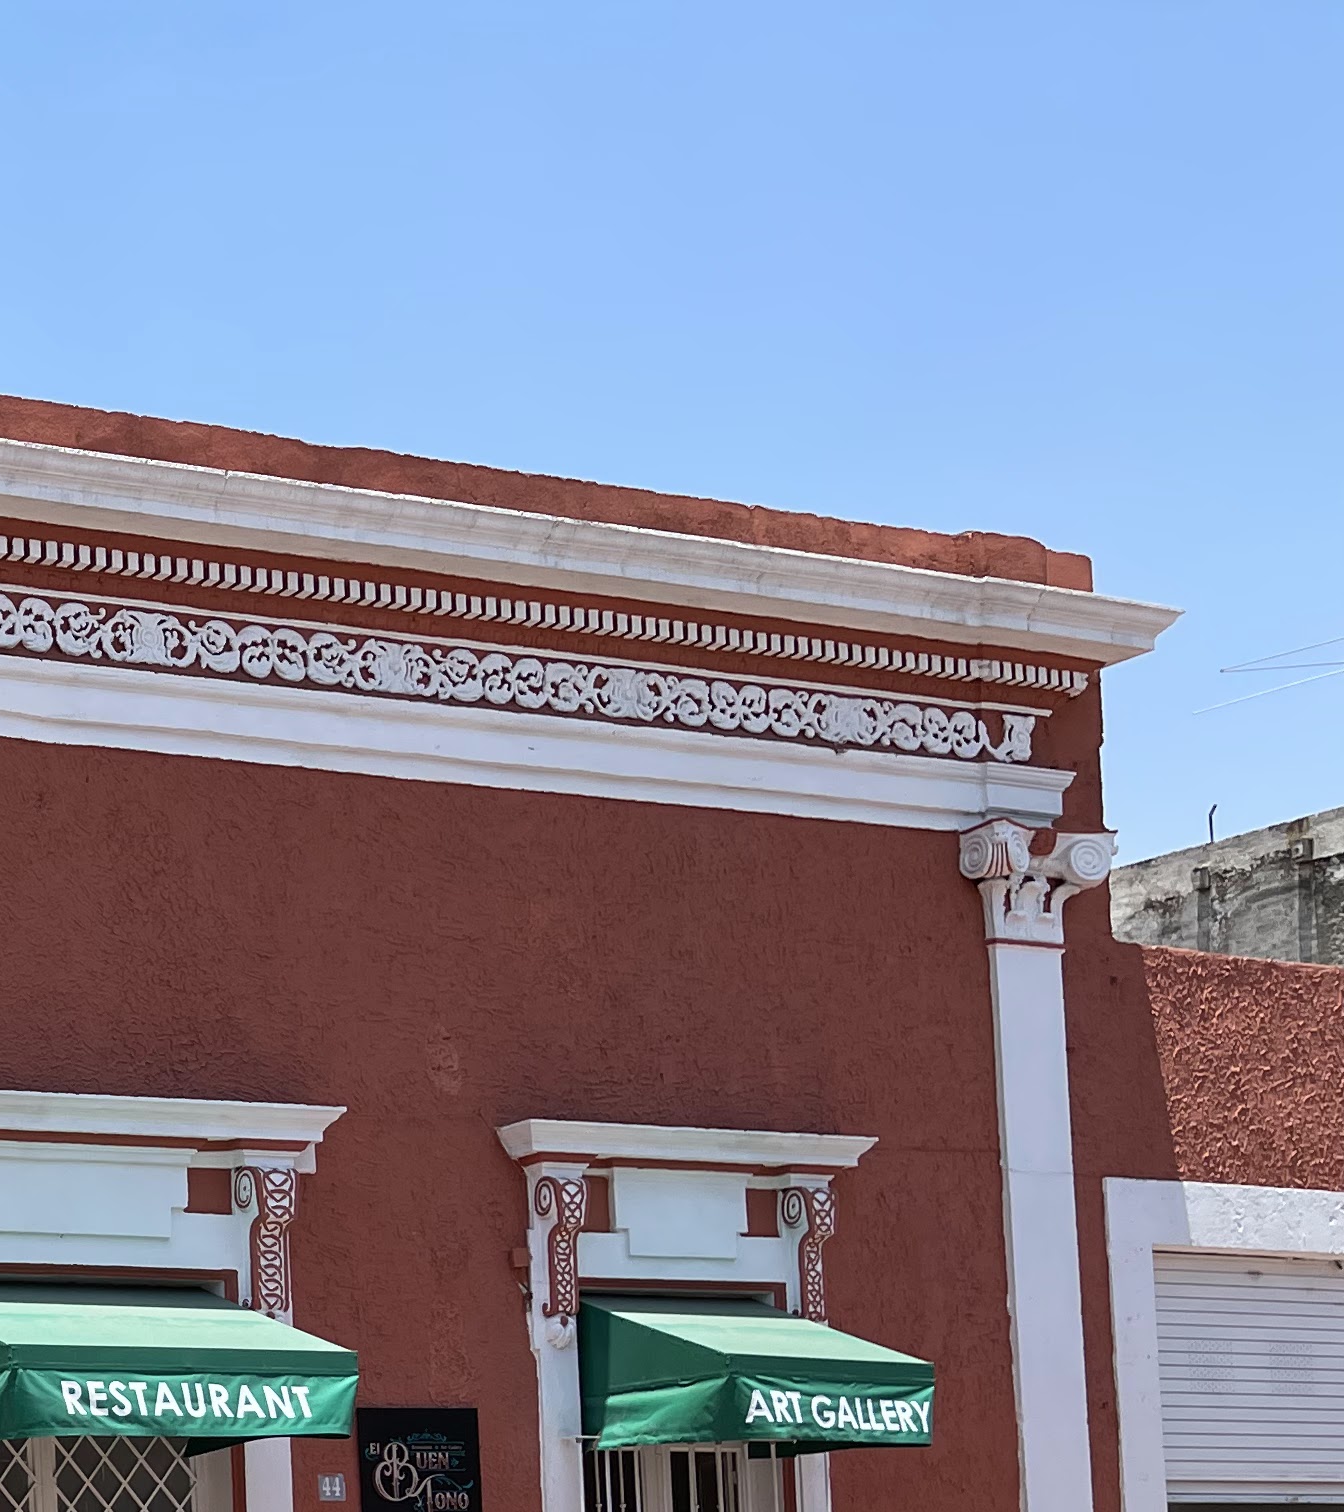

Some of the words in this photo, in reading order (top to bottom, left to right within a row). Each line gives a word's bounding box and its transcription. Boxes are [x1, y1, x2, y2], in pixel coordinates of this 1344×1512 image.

[59, 1379, 314, 1420] RESTAURANT
[744, 1388, 804, 1425] ART
[811, 1394, 932, 1434] GALLERY
[322, 1476, 341, 1496] 44
